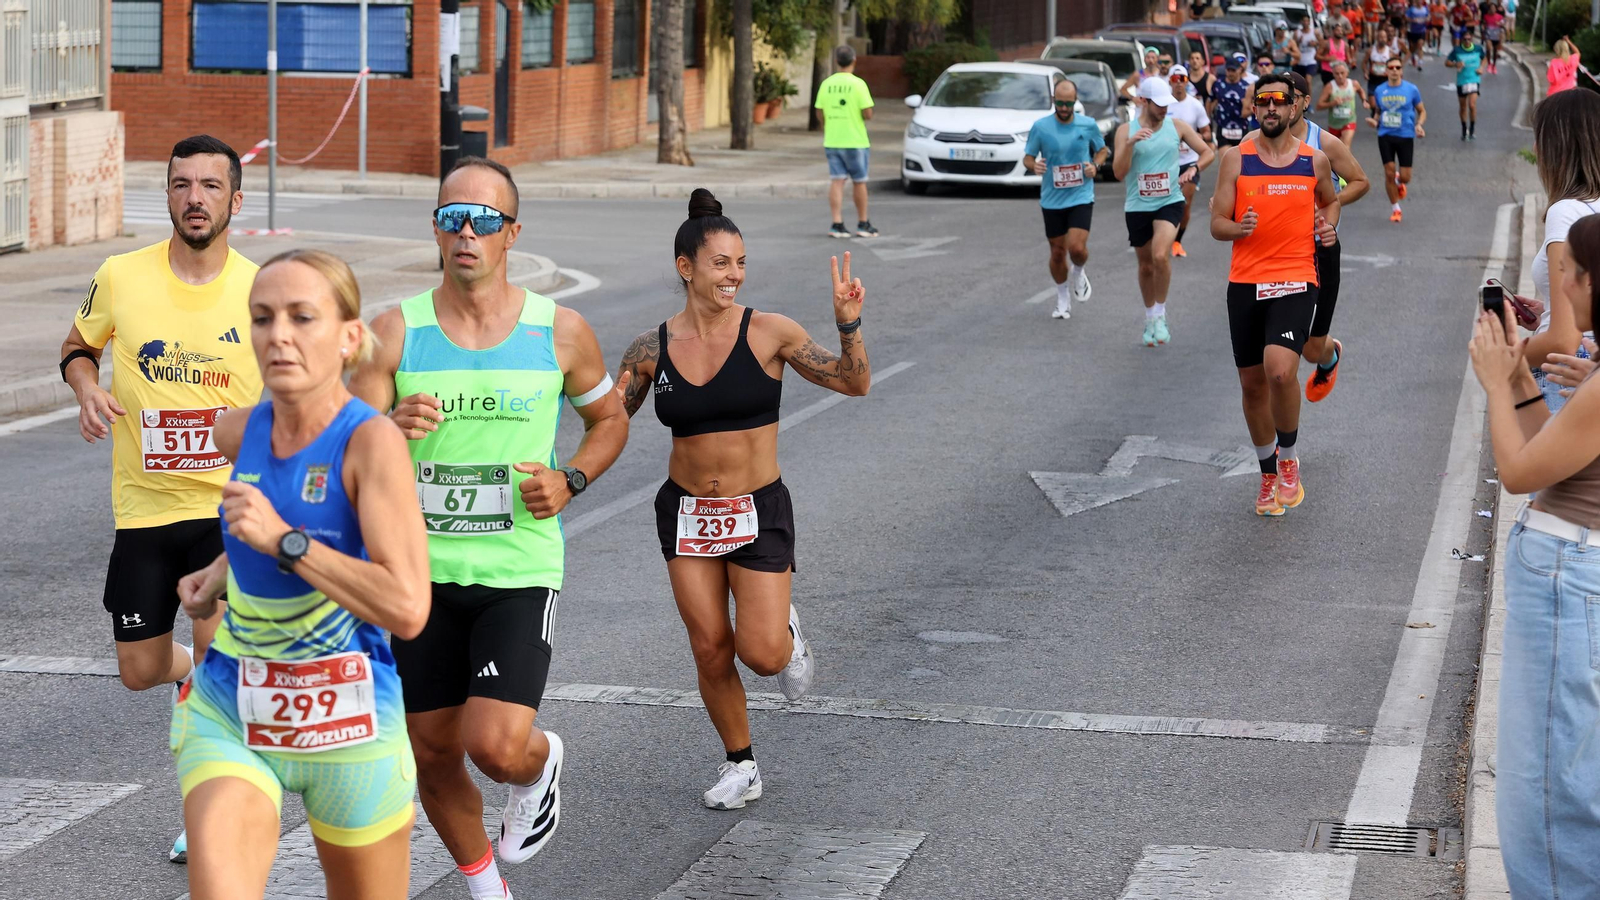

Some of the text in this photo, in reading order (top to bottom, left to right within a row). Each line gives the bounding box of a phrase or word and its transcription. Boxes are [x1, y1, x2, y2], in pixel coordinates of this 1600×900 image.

[1061, 172, 1076, 181] 383
[1145, 181, 1163, 190] 505
[655, 385, 673, 394] ELITE
[163, 430, 209, 451] 517
[444, 488, 477, 512] 67
[448, 520, 506, 531] MIZUNO
[696, 517, 737, 538] 239
[270, 690, 338, 722] 299
[291, 724, 368, 747] MIZUNO
